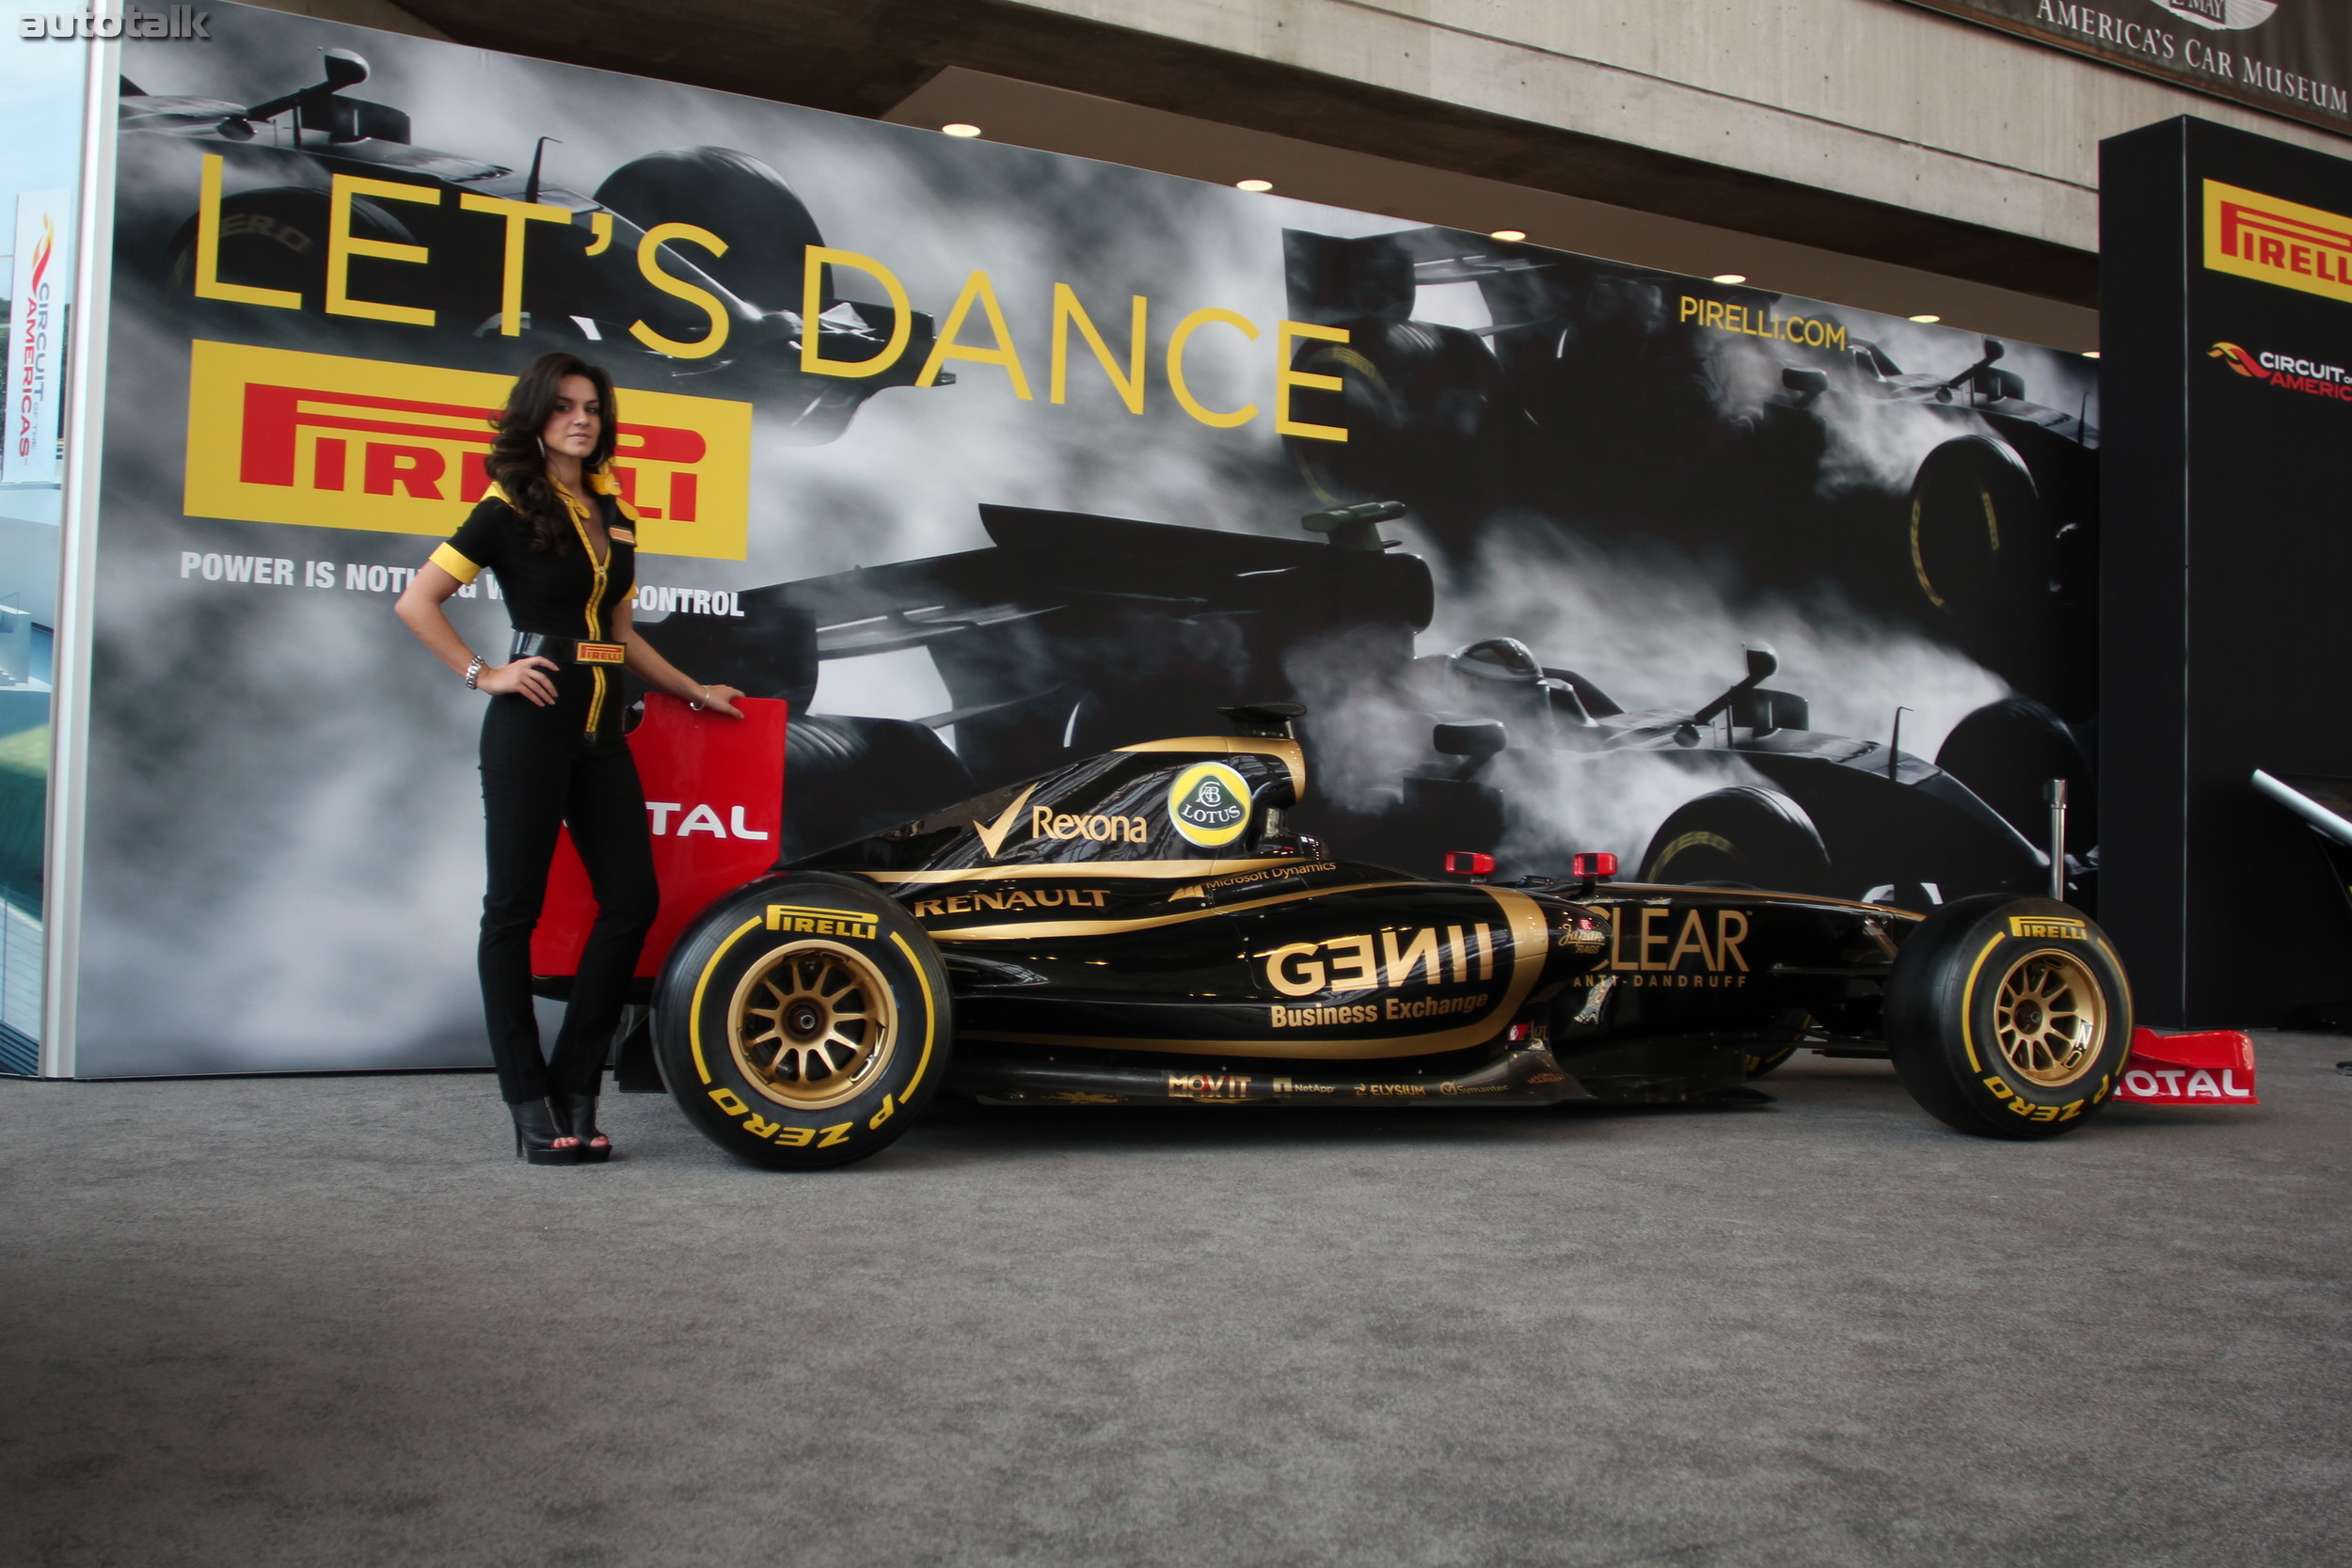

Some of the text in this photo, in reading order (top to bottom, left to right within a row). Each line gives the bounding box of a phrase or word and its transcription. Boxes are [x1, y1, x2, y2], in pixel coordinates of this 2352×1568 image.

[2036, 0, 2348, 114] AMERICA'S CAR MUSEUM
[194, 152, 1349, 442] LET'S DANCE
[34, 281, 50, 402] CIRCUIT
[1680, 295, 1846, 352] PIRELLI.COM
[19, 296, 38, 458] AMERICAS
[2260, 352, 2345, 384] CIRCUIT
[181, 551, 294, 586] POWER
[305, 561, 334, 589] IS
[580, 644, 622, 661] PIRELLI
[1032, 806, 1147, 843] Rexona
[1182, 803, 1241, 824] LOTUS
[1206, 862, 1337, 889] Microsoft Dynamics
[914, 889, 1111, 918] RENAULT
[766, 904, 879, 940] PIRELLI
[2010, 916, 2087, 941] PIRELLI
[1272, 993, 1488, 1028] Business Exchange
[1295, 1084, 1334, 1093] NetApp
[1370, 1084, 1426, 1096] ELYSIUM
[1983, 1073, 2109, 1121] P ZERO
[708, 1087, 894, 1148] P ZERO
